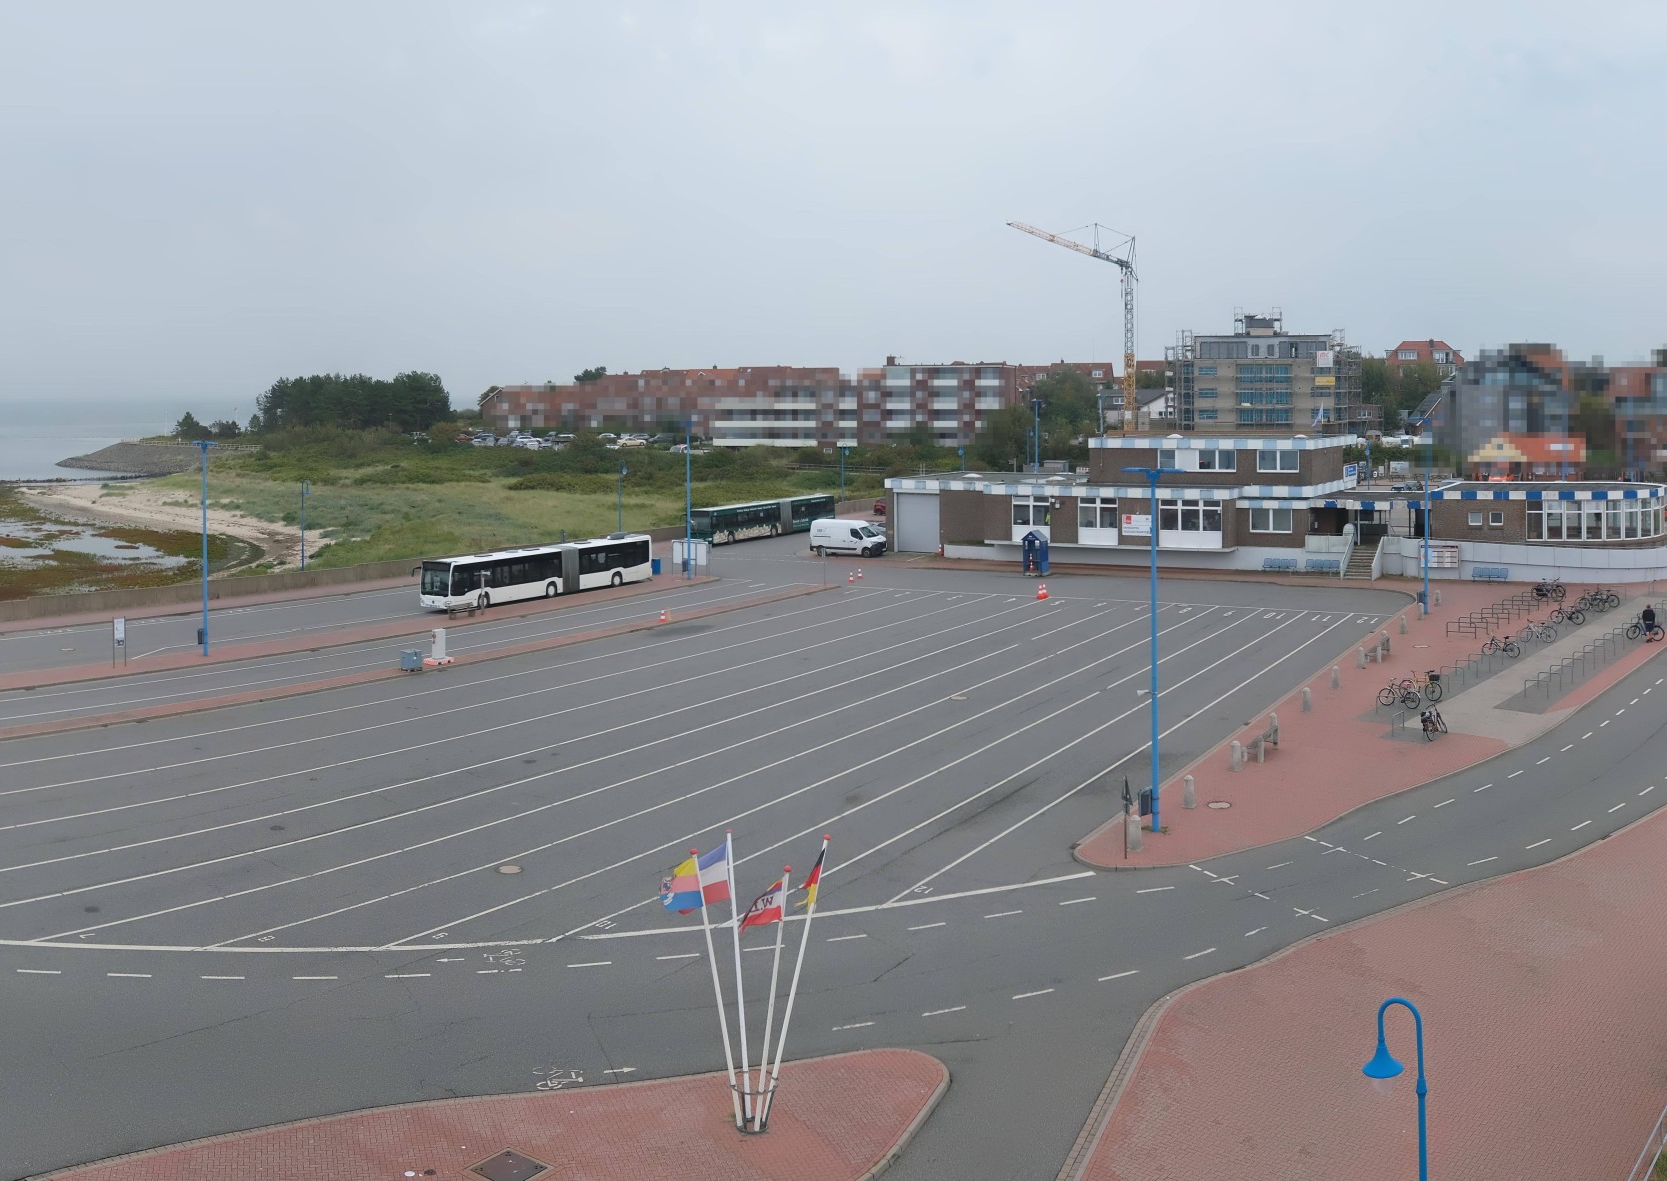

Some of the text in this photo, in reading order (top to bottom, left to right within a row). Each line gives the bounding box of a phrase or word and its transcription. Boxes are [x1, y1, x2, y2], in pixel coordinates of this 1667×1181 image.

[1311, 614, 1332, 622] 11
[1356, 616, 1379, 624] 12
[913, 885, 934, 894] 12
